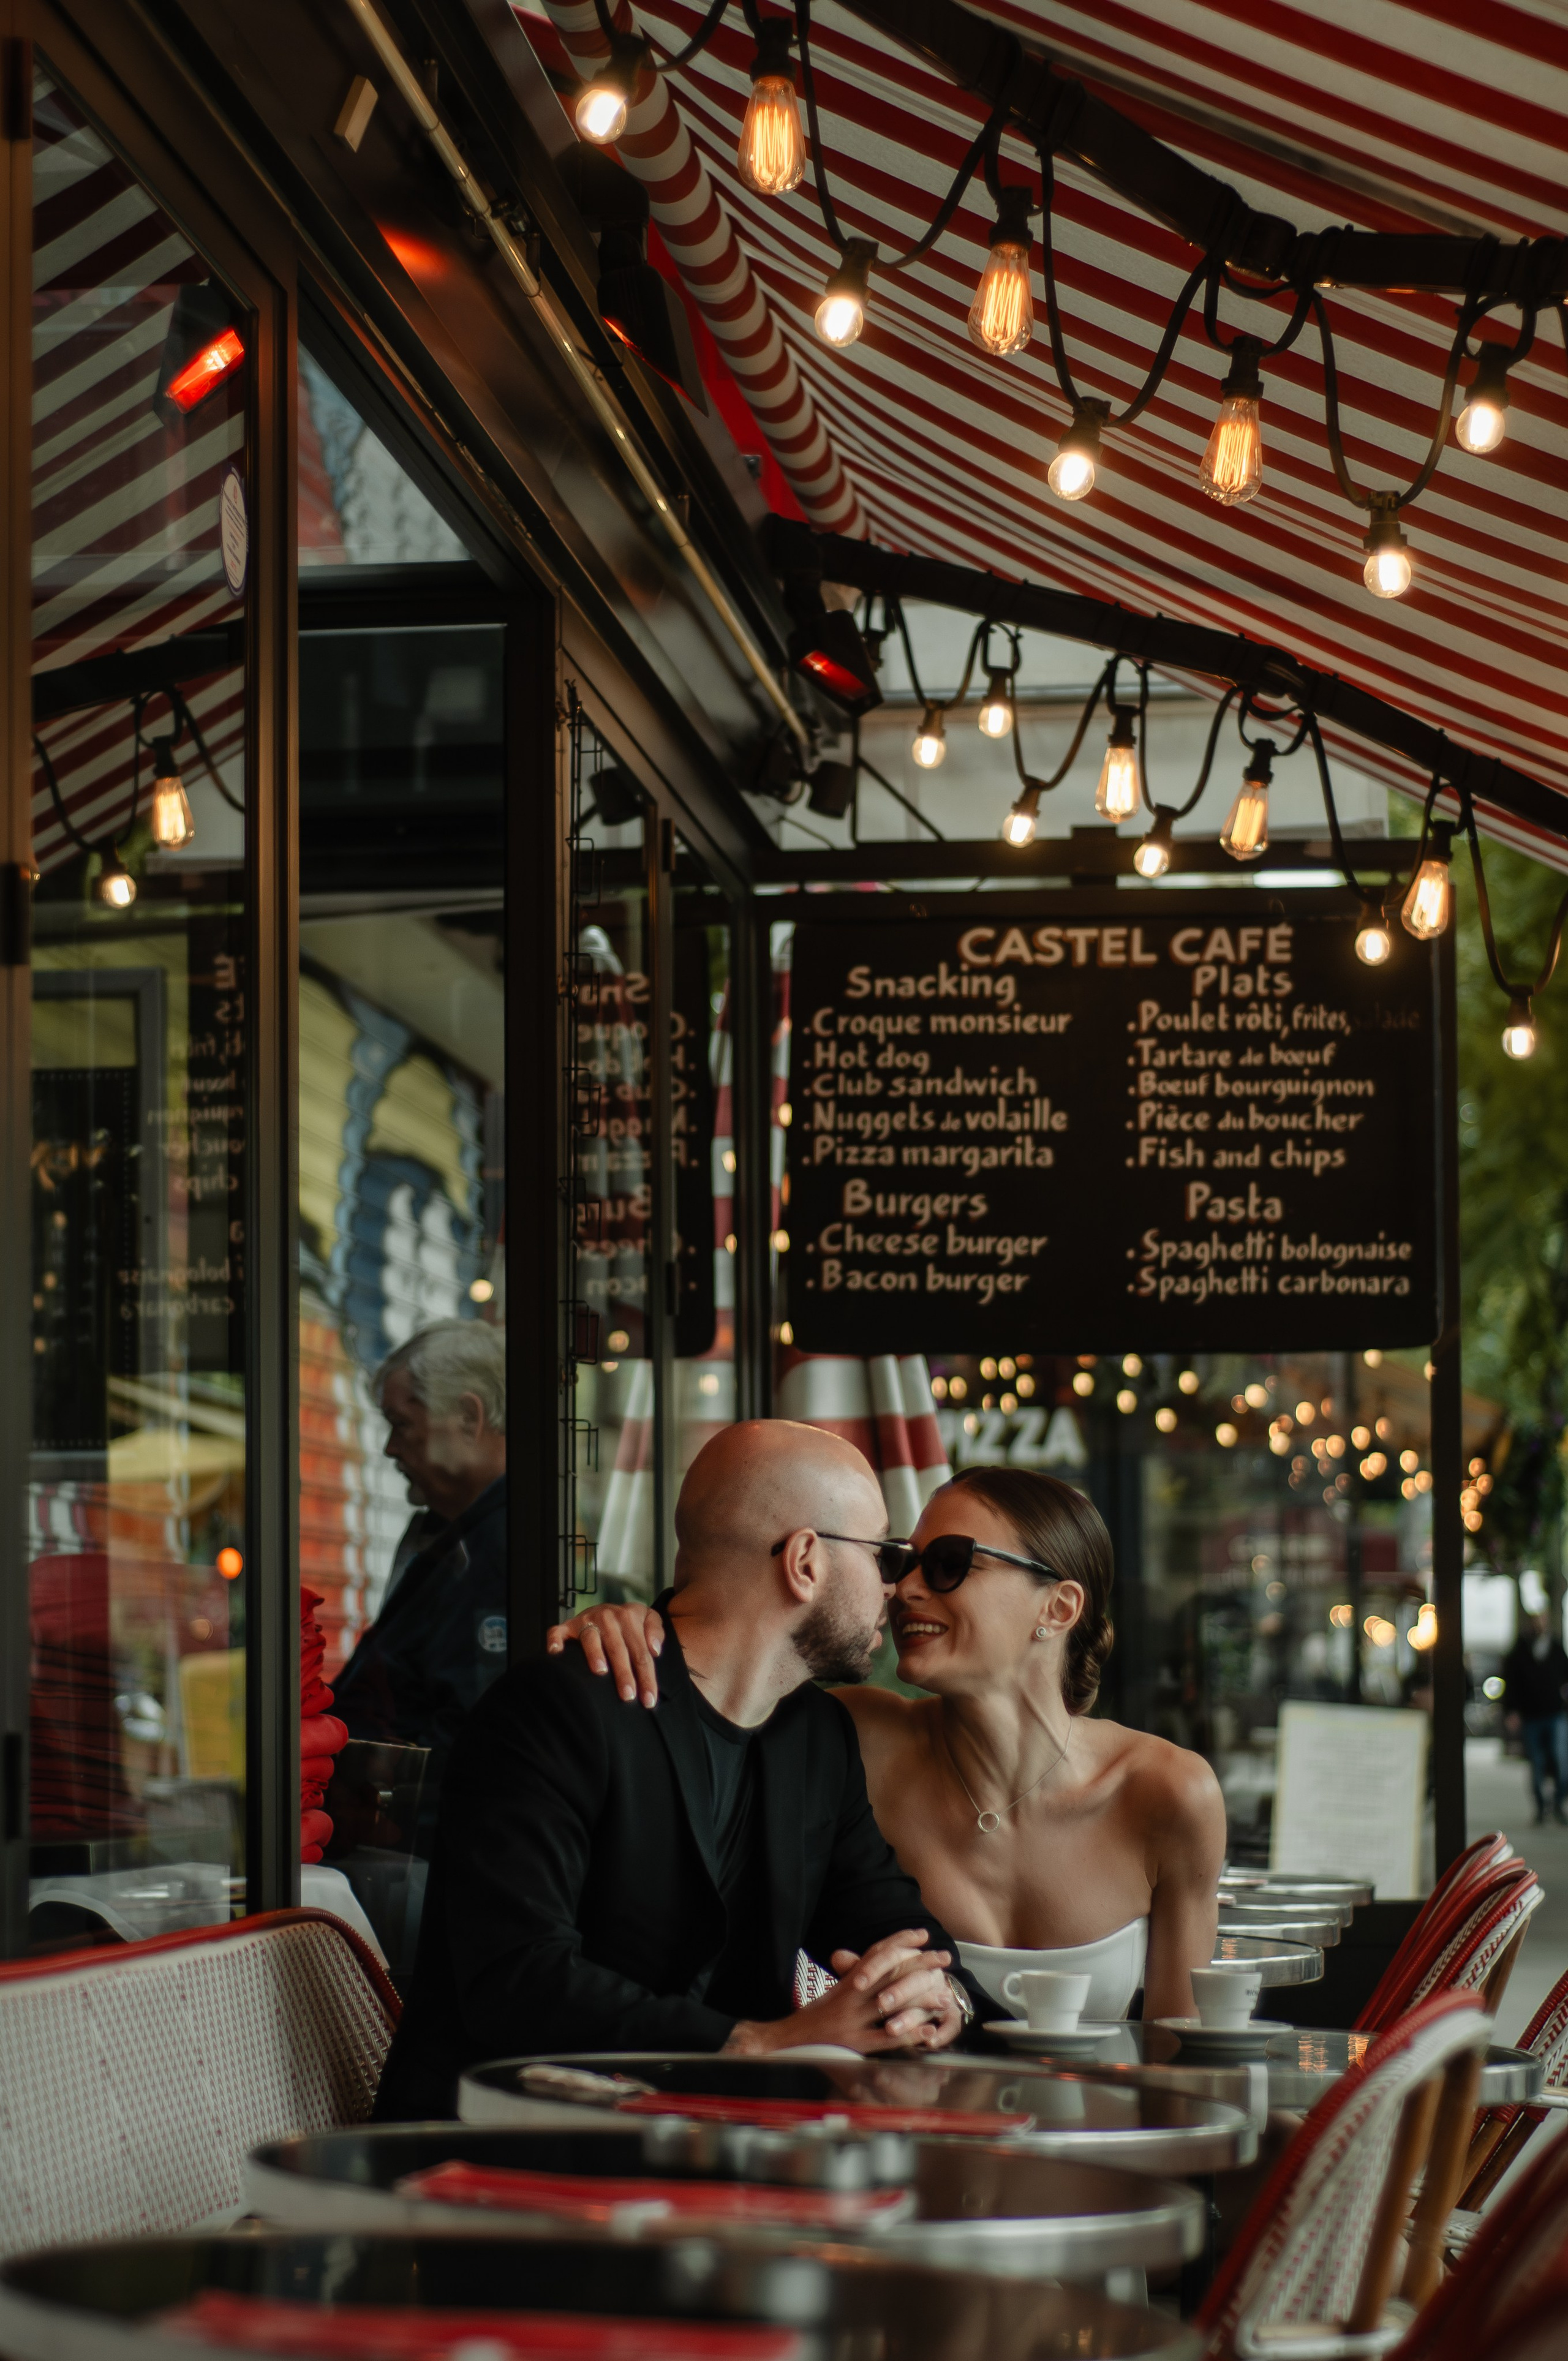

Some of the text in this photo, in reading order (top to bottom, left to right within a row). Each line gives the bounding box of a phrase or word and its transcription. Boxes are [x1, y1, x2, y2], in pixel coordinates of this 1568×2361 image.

[957, 922, 1294, 967] CASTEL CAFÉ
[846, 962, 1016, 1008] Snacking
[1193, 963, 1293, 998] Plats
[813, 1001, 1072, 1044] Croque monsieur
[1139, 999, 1228, 1033] Poulet
[815, 1041, 929, 1074] Hot dog
[1134, 1037, 1232, 1068] Tartare
[1239, 1047, 1264, 1066] de
[812, 1064, 1037, 1097] Club sandwich
[1215, 1068, 1374, 1104] bourguignon
[814, 1097, 1068, 1140] Nuggets de volaille
[1218, 1111, 1245, 1130] du
[1248, 1101, 1363, 1132] boucher
[814, 1134, 1054, 1176] Pizza margarita
[1139, 1137, 1346, 1176] Fish and chips
[844, 1179, 987, 1231] Burgers
[1186, 1181, 1283, 1222] Pasta
[820, 1221, 1047, 1265] Cheese burger
[1142, 1229, 1411, 1269] Spaghetti bolognaise
[823, 1259, 1029, 1304] Bacon burger
[1138, 1264, 1409, 1303] Spaghetti carbonara
